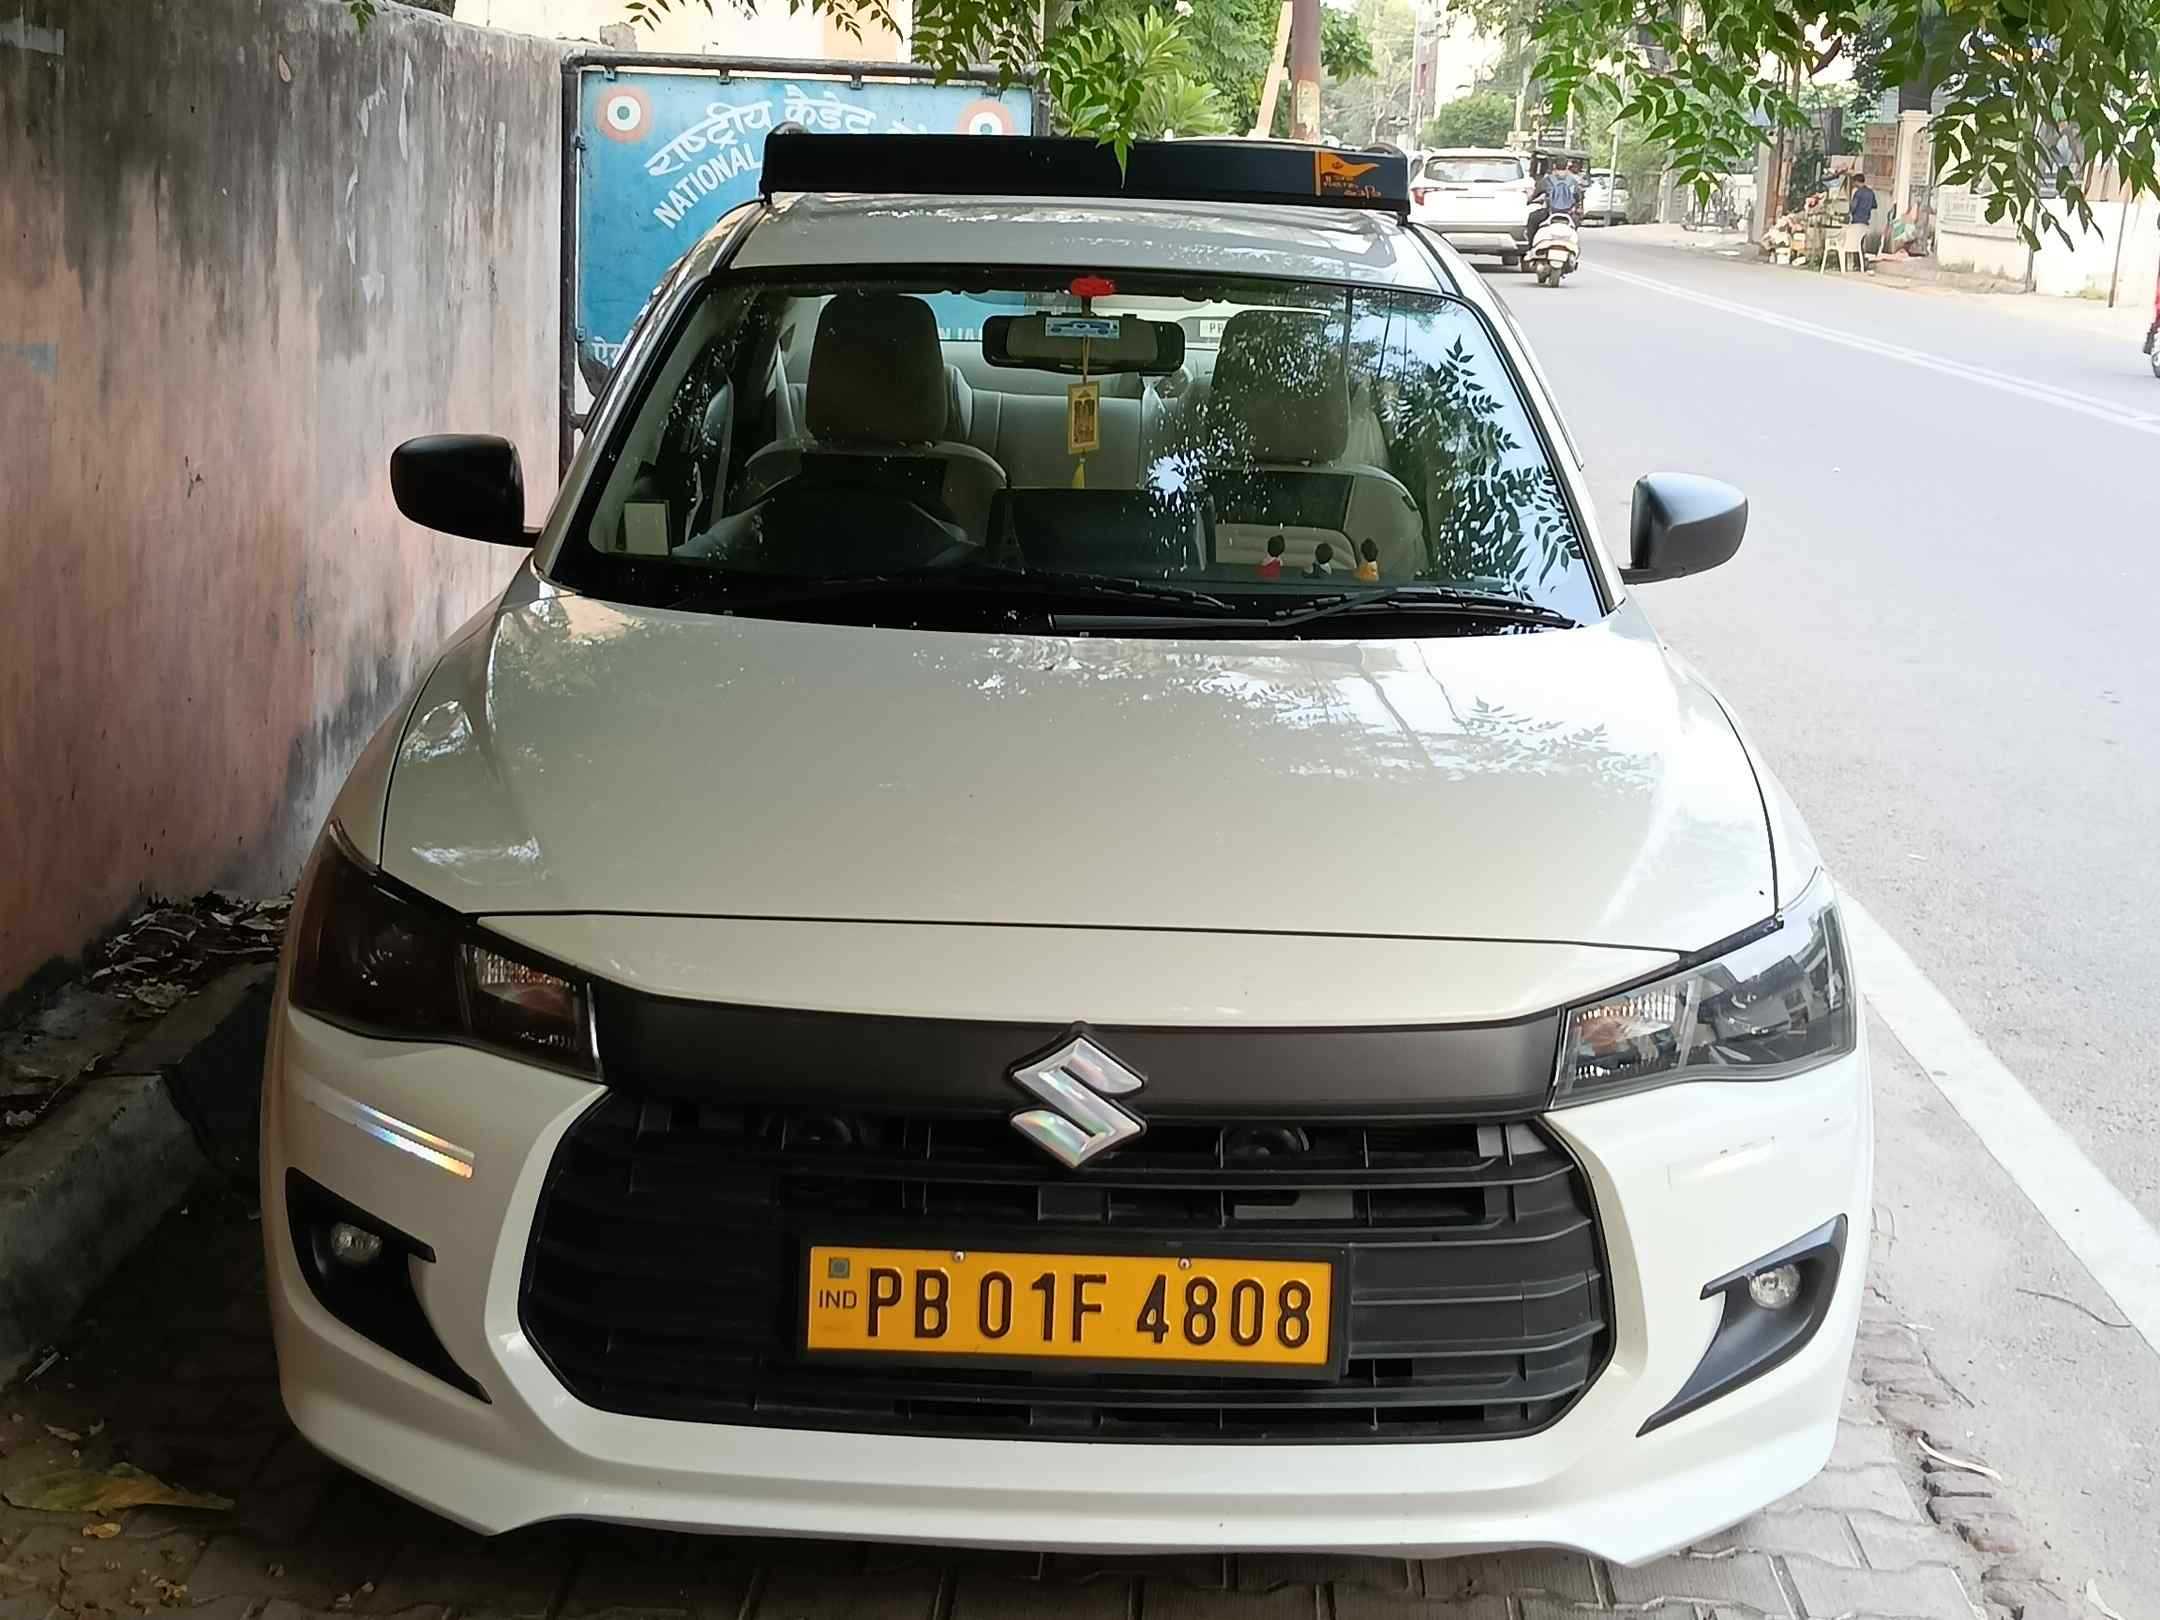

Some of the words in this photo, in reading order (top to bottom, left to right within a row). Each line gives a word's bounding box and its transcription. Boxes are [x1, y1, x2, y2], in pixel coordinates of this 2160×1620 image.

[652, 143, 763, 230] NATIONAL
[819, 1289, 858, 1309] IND
[867, 1267, 951, 1339] PB
[978, 1270, 1107, 1344] 01F
[1136, 1273, 1312, 1349] 4808
